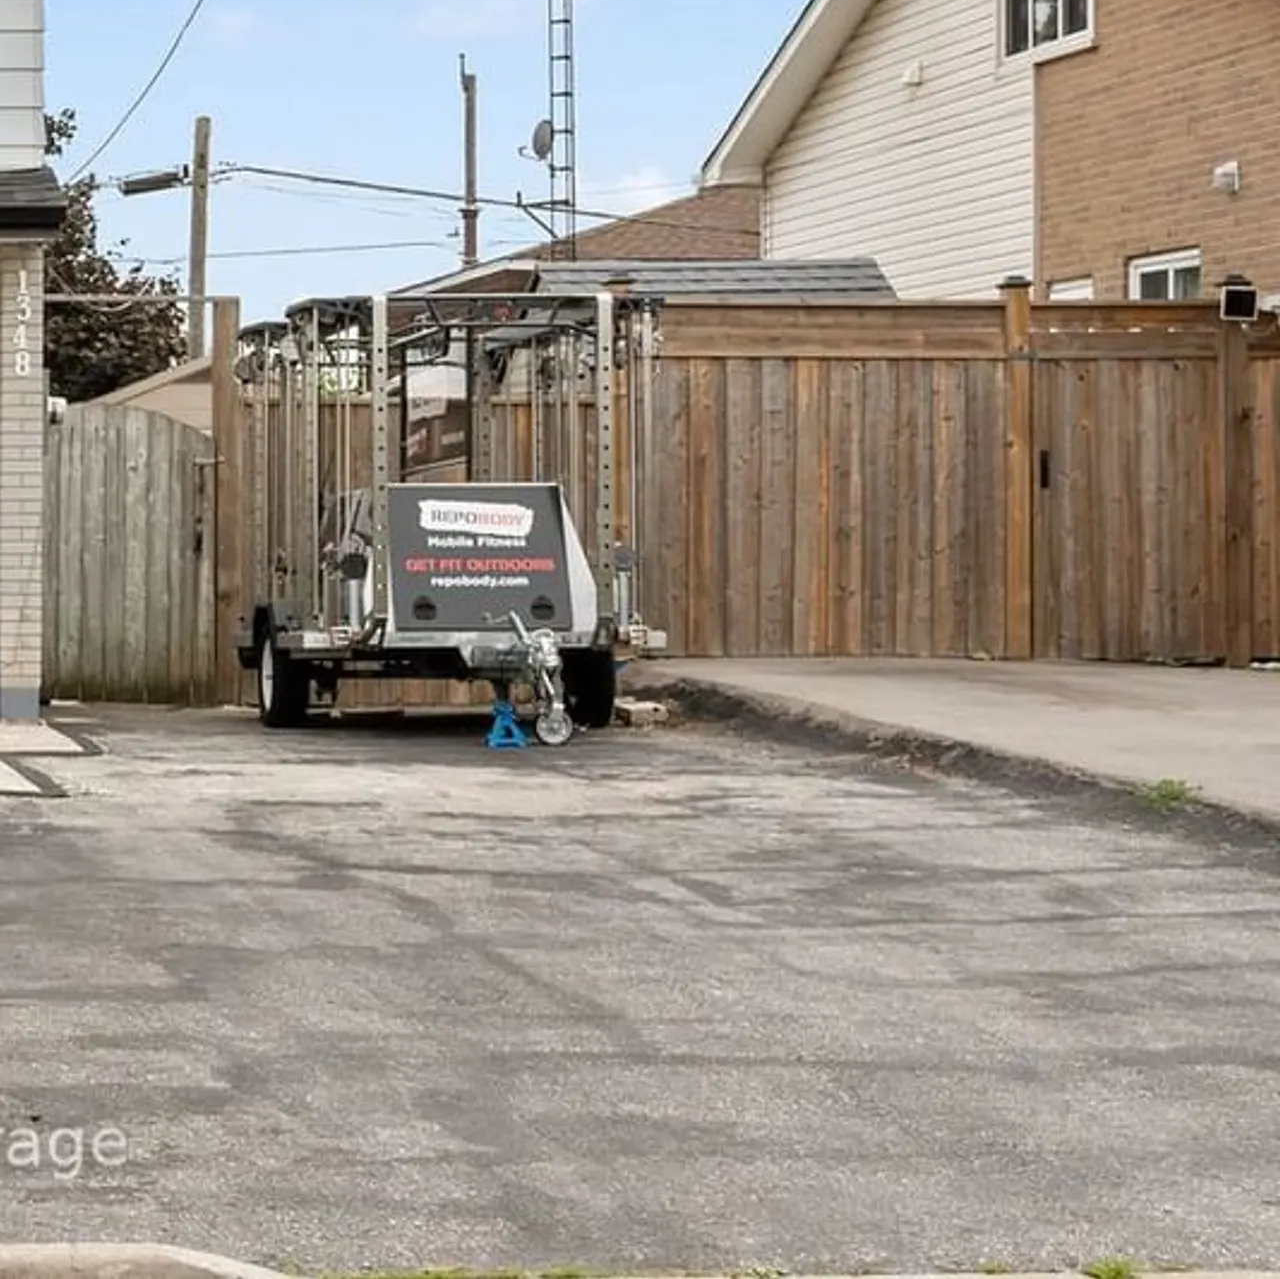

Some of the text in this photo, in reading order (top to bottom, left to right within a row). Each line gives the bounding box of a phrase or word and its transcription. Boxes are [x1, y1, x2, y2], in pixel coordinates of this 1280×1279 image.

[12, 270, 31, 376] 1348
[427, 536, 527, 548] Mobile Fitness
[405, 557, 554, 571] GET FIT OUTDOORS
[430, 576, 529, 589] repobody.com
